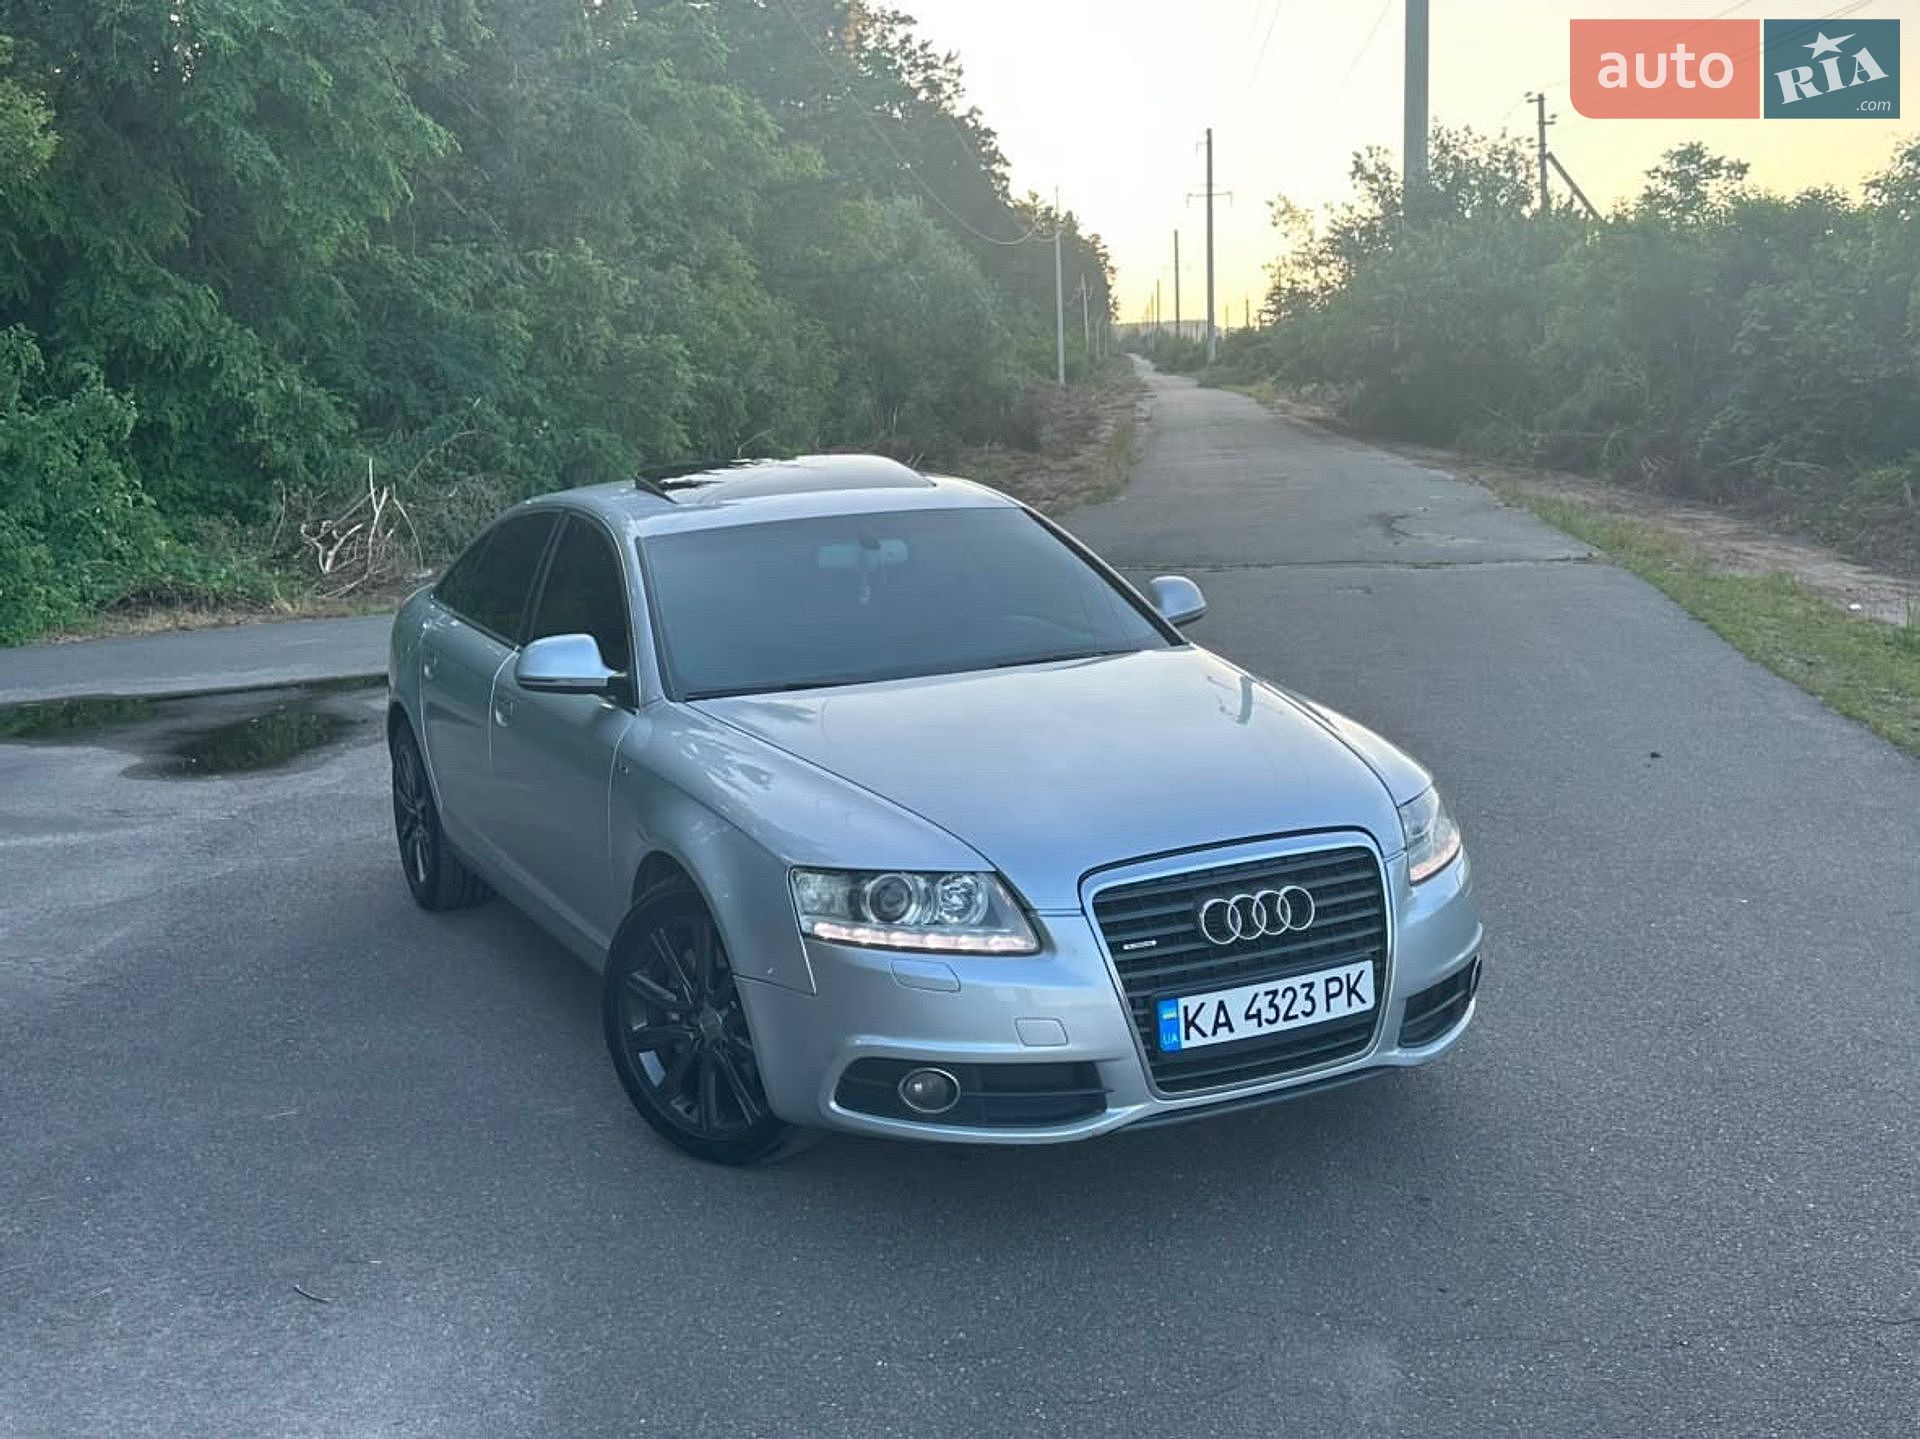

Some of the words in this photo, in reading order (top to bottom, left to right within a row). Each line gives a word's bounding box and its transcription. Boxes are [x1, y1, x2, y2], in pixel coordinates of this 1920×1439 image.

[1183, 1000, 1235, 1041] KA
[1244, 981, 1317, 1028] 4323
[1325, 970, 1367, 1013] PK
